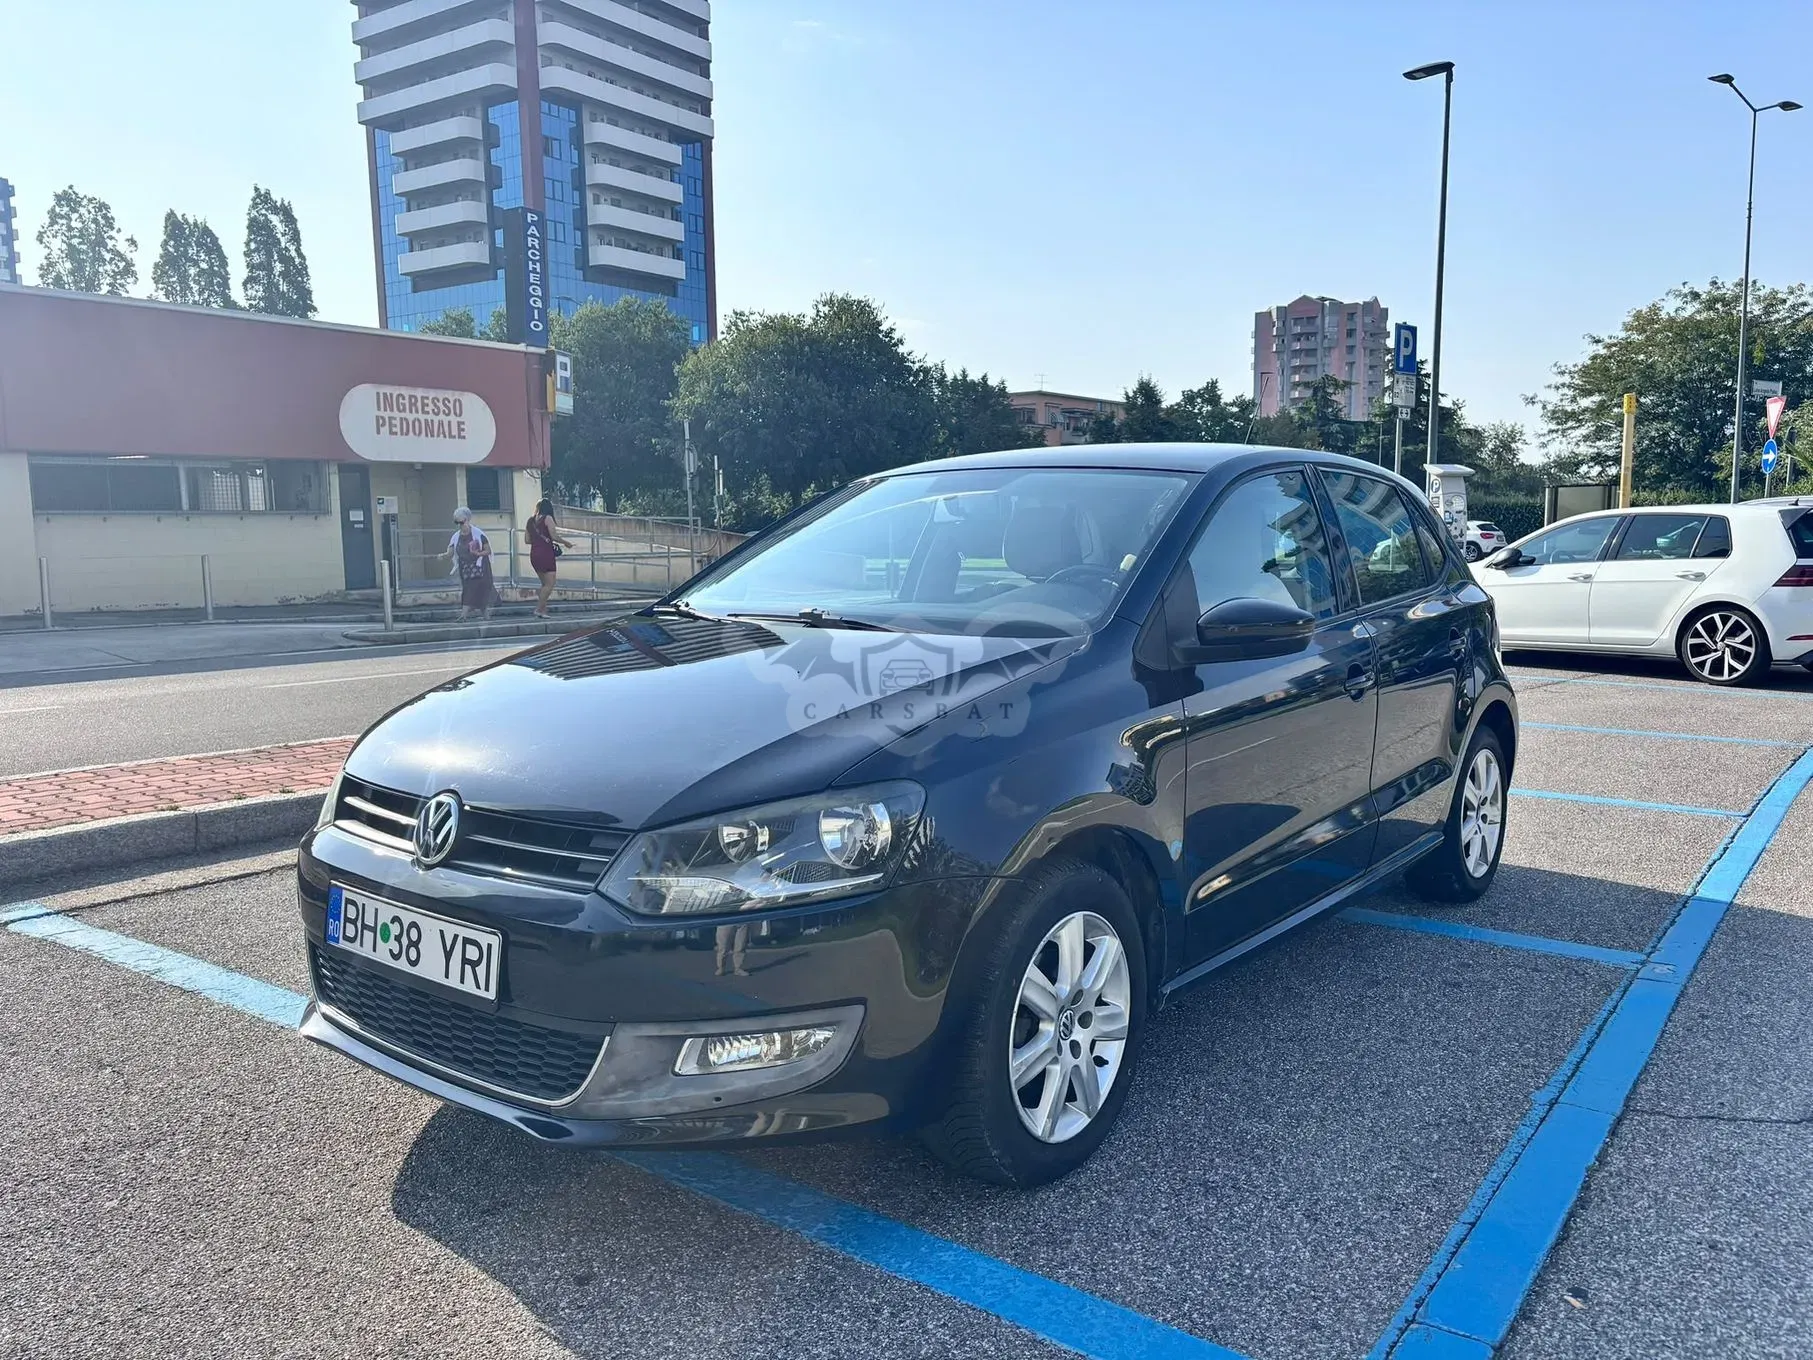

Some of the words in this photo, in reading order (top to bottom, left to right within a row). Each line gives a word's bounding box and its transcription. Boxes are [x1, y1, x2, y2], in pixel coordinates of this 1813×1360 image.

[526, 212, 544, 332] PARCHEGGIO
[1399, 329, 1414, 368] P
[556, 354, 571, 389] P
[375, 391, 464, 418] INGRESSO
[375, 415, 467, 440] PEDONALE
[328, 918, 341, 938] RO
[342, 896, 379, 953] BH
[388, 915, 422, 968] 38
[439, 928, 493, 993] YRI
